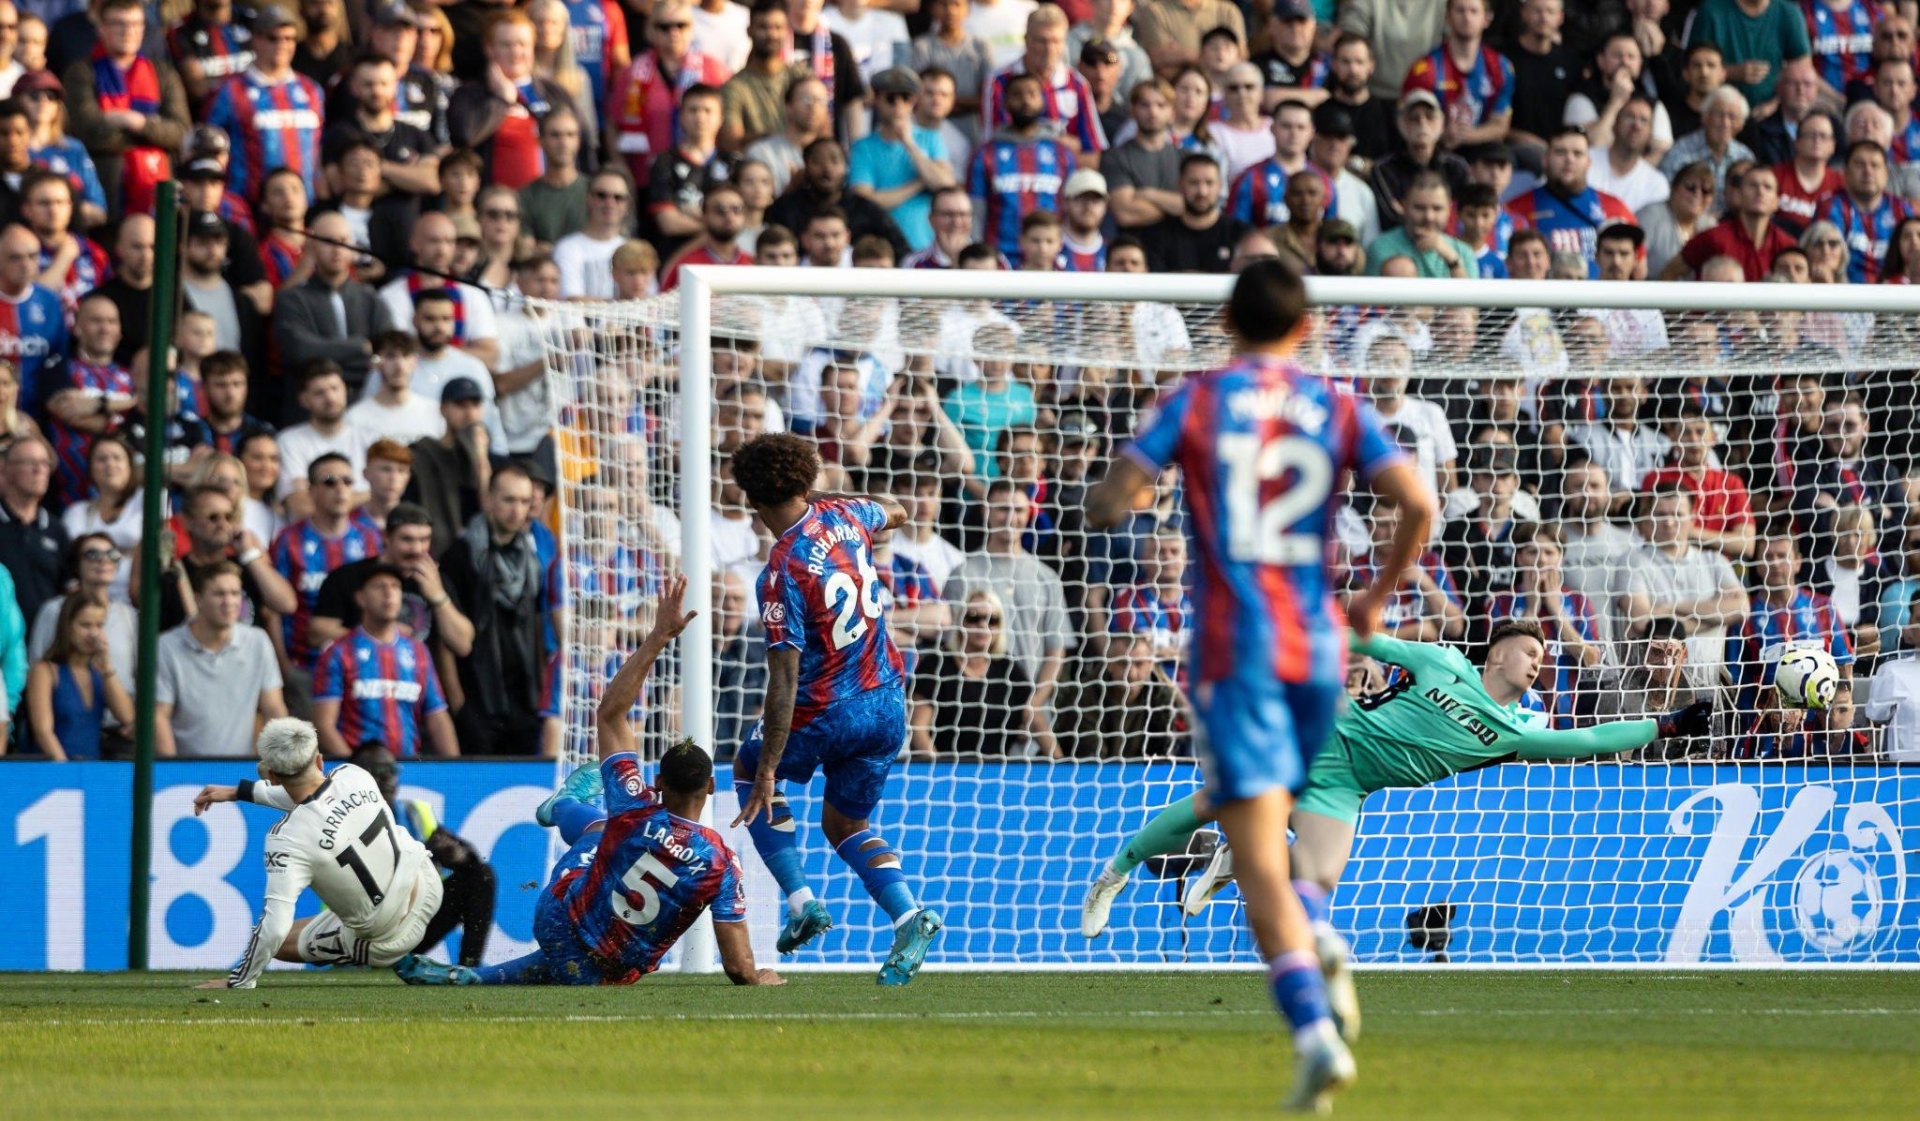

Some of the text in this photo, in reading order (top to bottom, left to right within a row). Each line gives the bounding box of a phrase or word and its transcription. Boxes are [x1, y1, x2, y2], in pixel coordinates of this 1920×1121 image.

[1217, 431, 1334, 565] 12
[807, 524, 861, 576] RICHARDS
[825, 543, 882, 650] 26
[318, 789, 379, 851] GARNACHO
[335, 807, 401, 907] 17
[643, 821, 707, 876] LACROIX
[611, 851, 680, 926] 5
